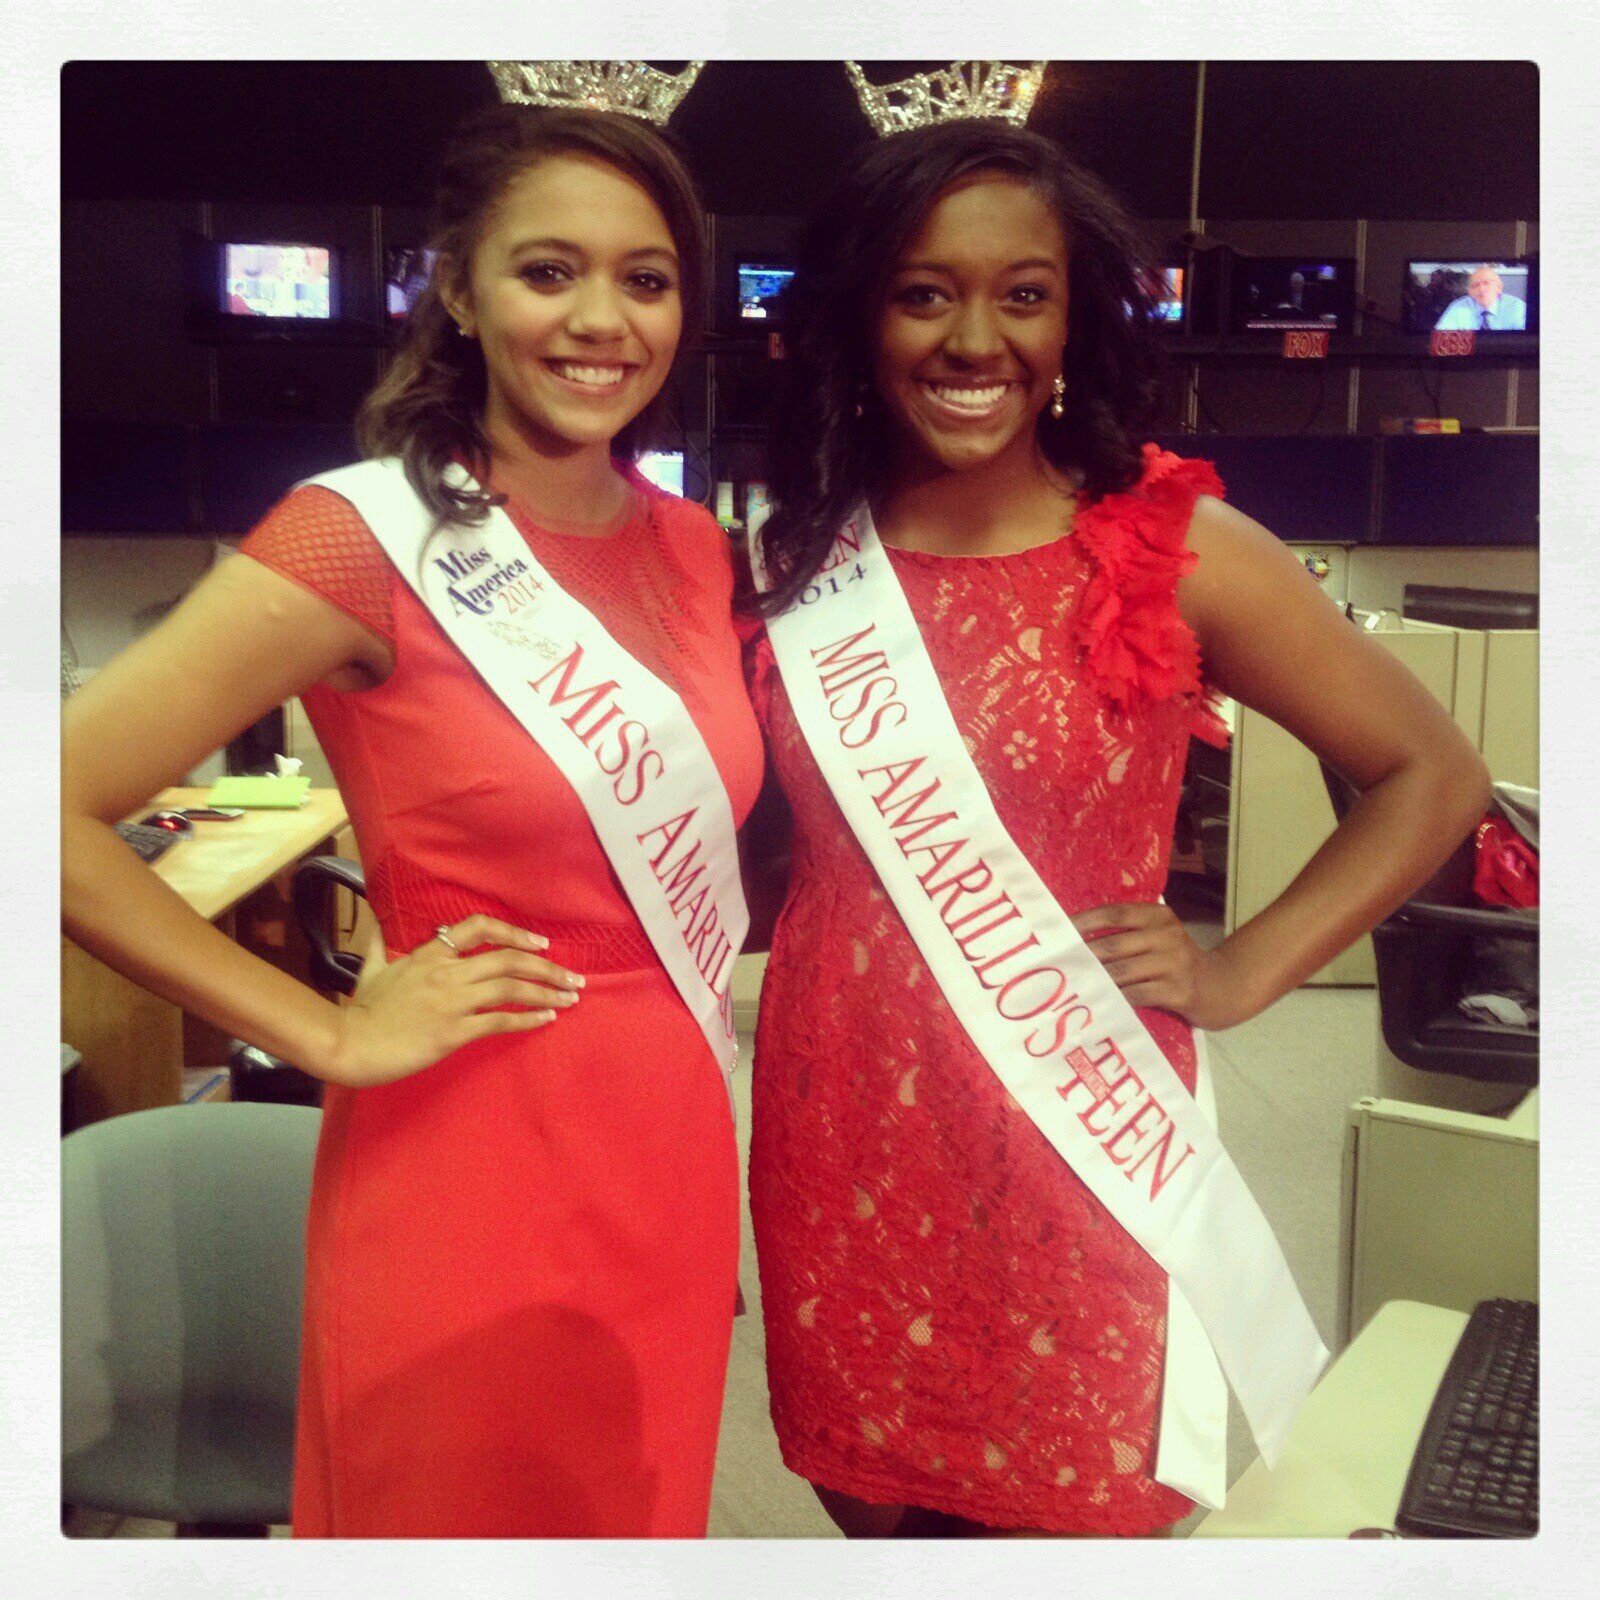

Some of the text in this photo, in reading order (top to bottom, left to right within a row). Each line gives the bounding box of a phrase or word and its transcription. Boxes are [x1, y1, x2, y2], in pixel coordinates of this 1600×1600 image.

[1287, 333, 1324, 358] FOX
[434, 547, 492, 585] Miss
[447, 559, 528, 617] America
[498, 574, 544, 614] 2014
[779, 563, 867, 617] 014
[810, 622, 907, 749] MISS
[857, 755, 1093, 1058] AMARILLO'S
[1056, 1036, 1196, 1203] TEEN
